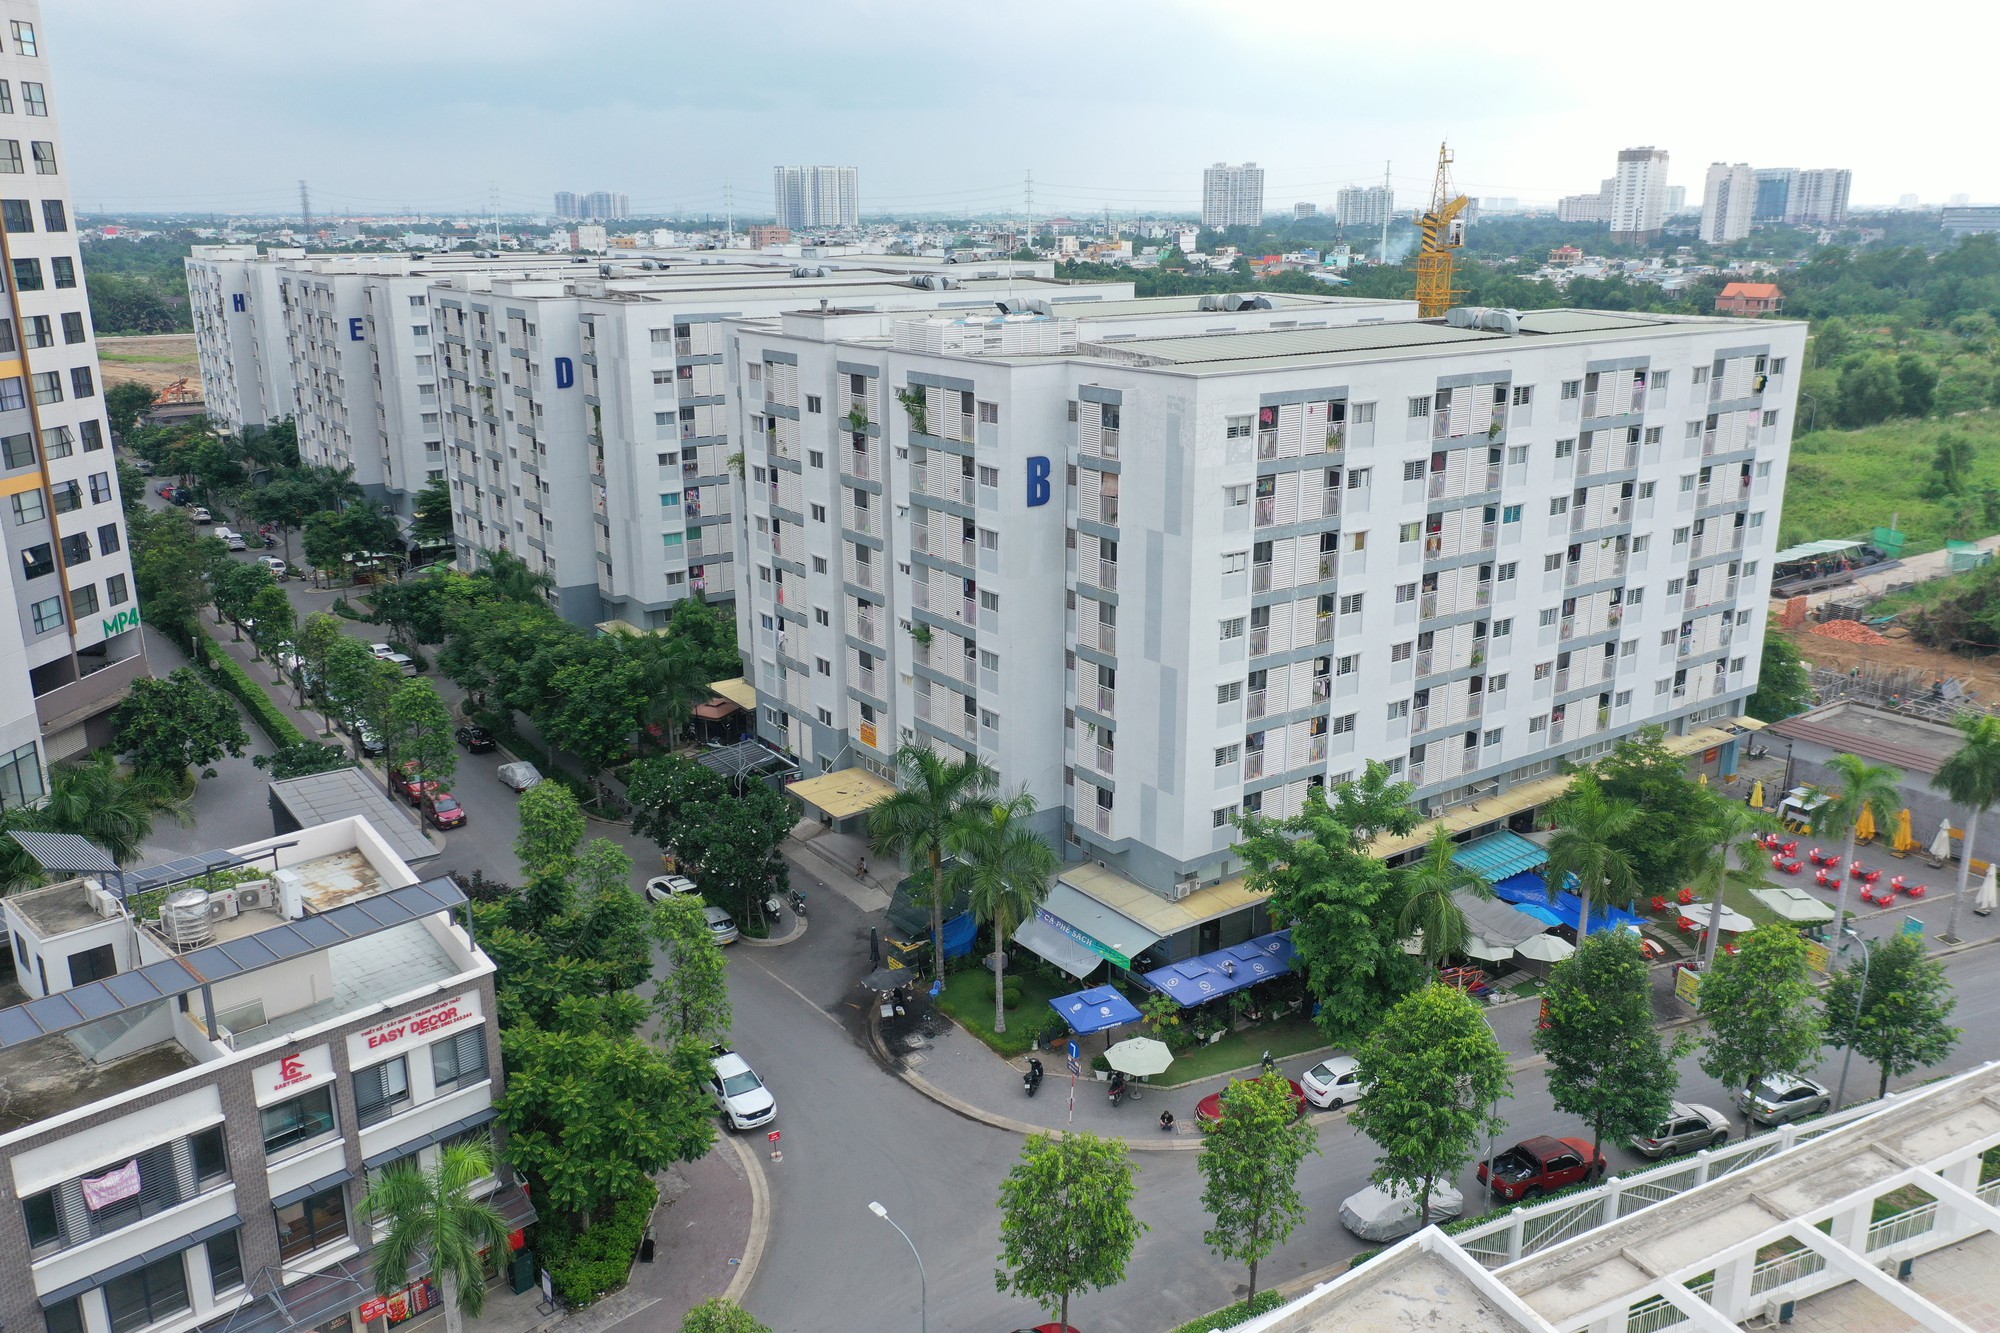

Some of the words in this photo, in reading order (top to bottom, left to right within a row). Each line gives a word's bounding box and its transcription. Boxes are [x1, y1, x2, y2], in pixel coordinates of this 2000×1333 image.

[233, 294, 245, 312] H
[349, 318, 364, 341] E
[555, 357, 574, 389] D
[1027, 456, 1050, 507] B
[103, 607, 139, 638] MP4
[368, 1025, 406, 1049] EASY
[410, 1007, 458, 1033] DECOR
[274, 1081, 290, 1090] EASY
[291, 1074, 312, 1084] DECOR
